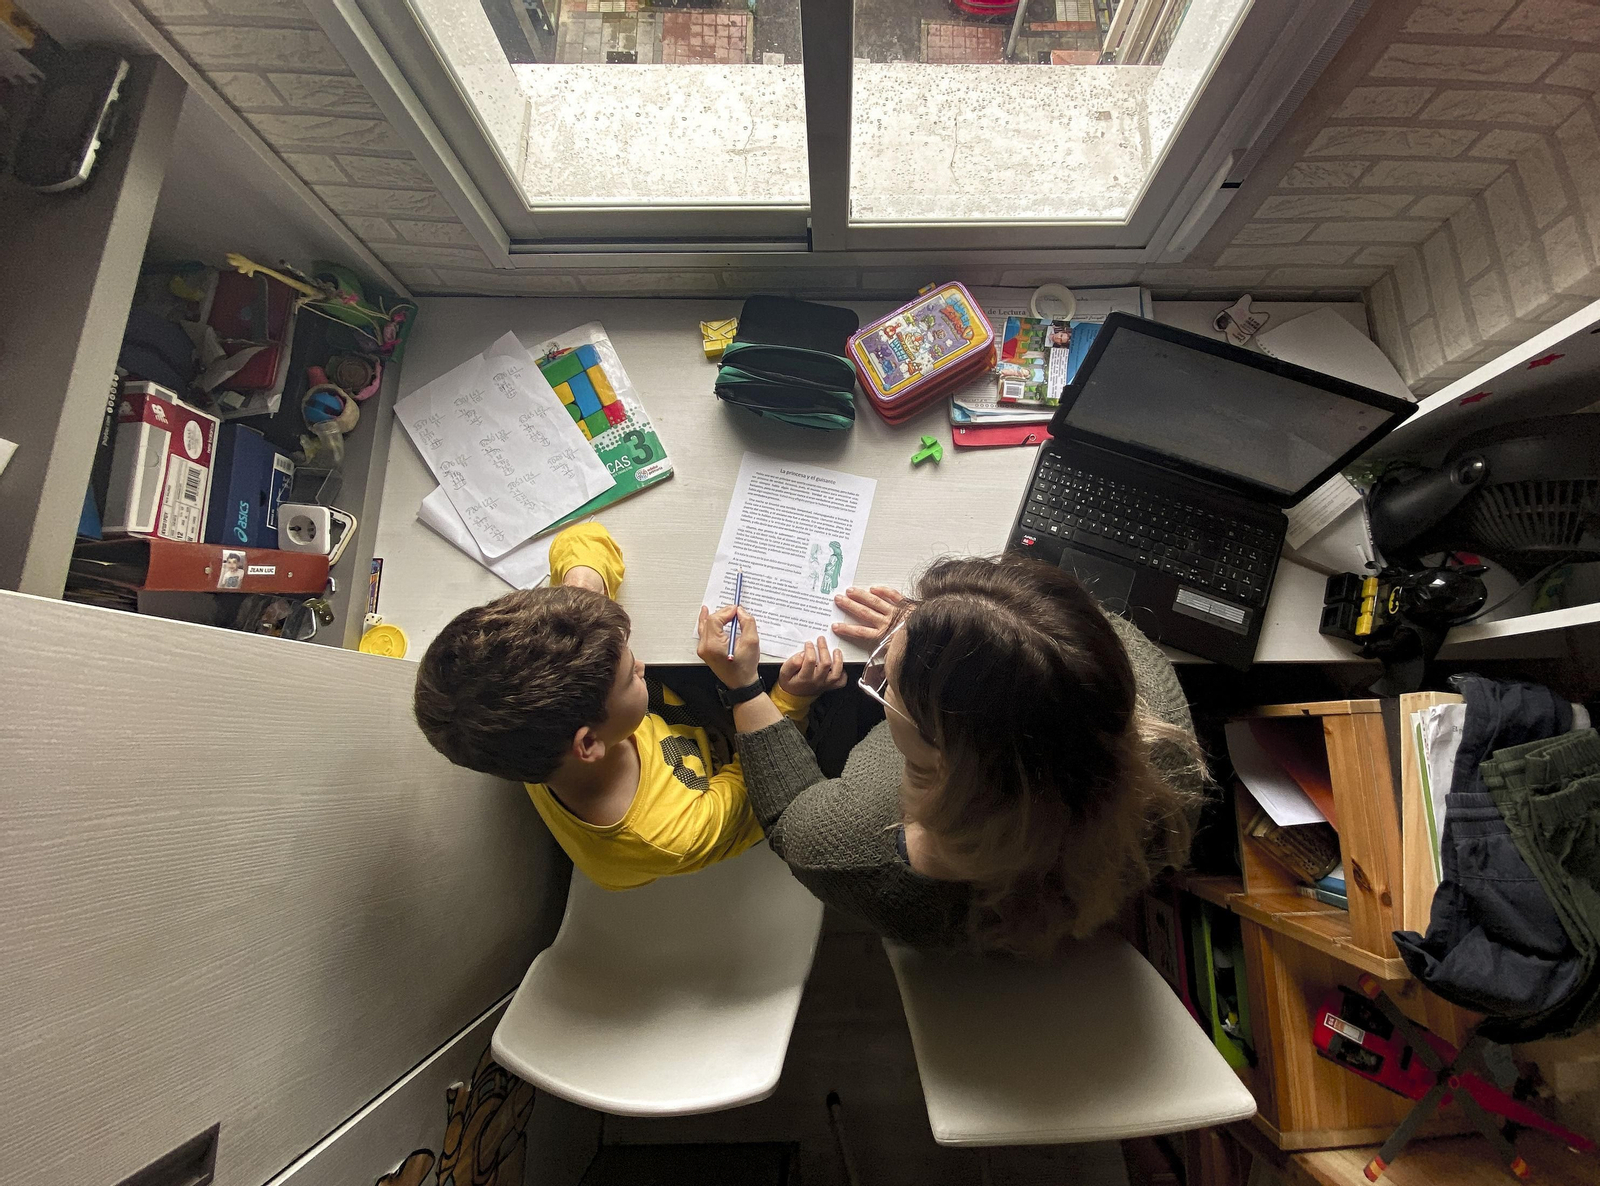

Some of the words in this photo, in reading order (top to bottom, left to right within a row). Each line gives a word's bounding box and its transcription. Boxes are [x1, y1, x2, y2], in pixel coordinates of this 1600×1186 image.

[998, 308, 1026, 317] Lectura
[624, 430, 654, 466] 3
[786, 470, 806, 479] princesa
[816, 476, 836, 485] guisante
[237, 501, 250, 525] asics
